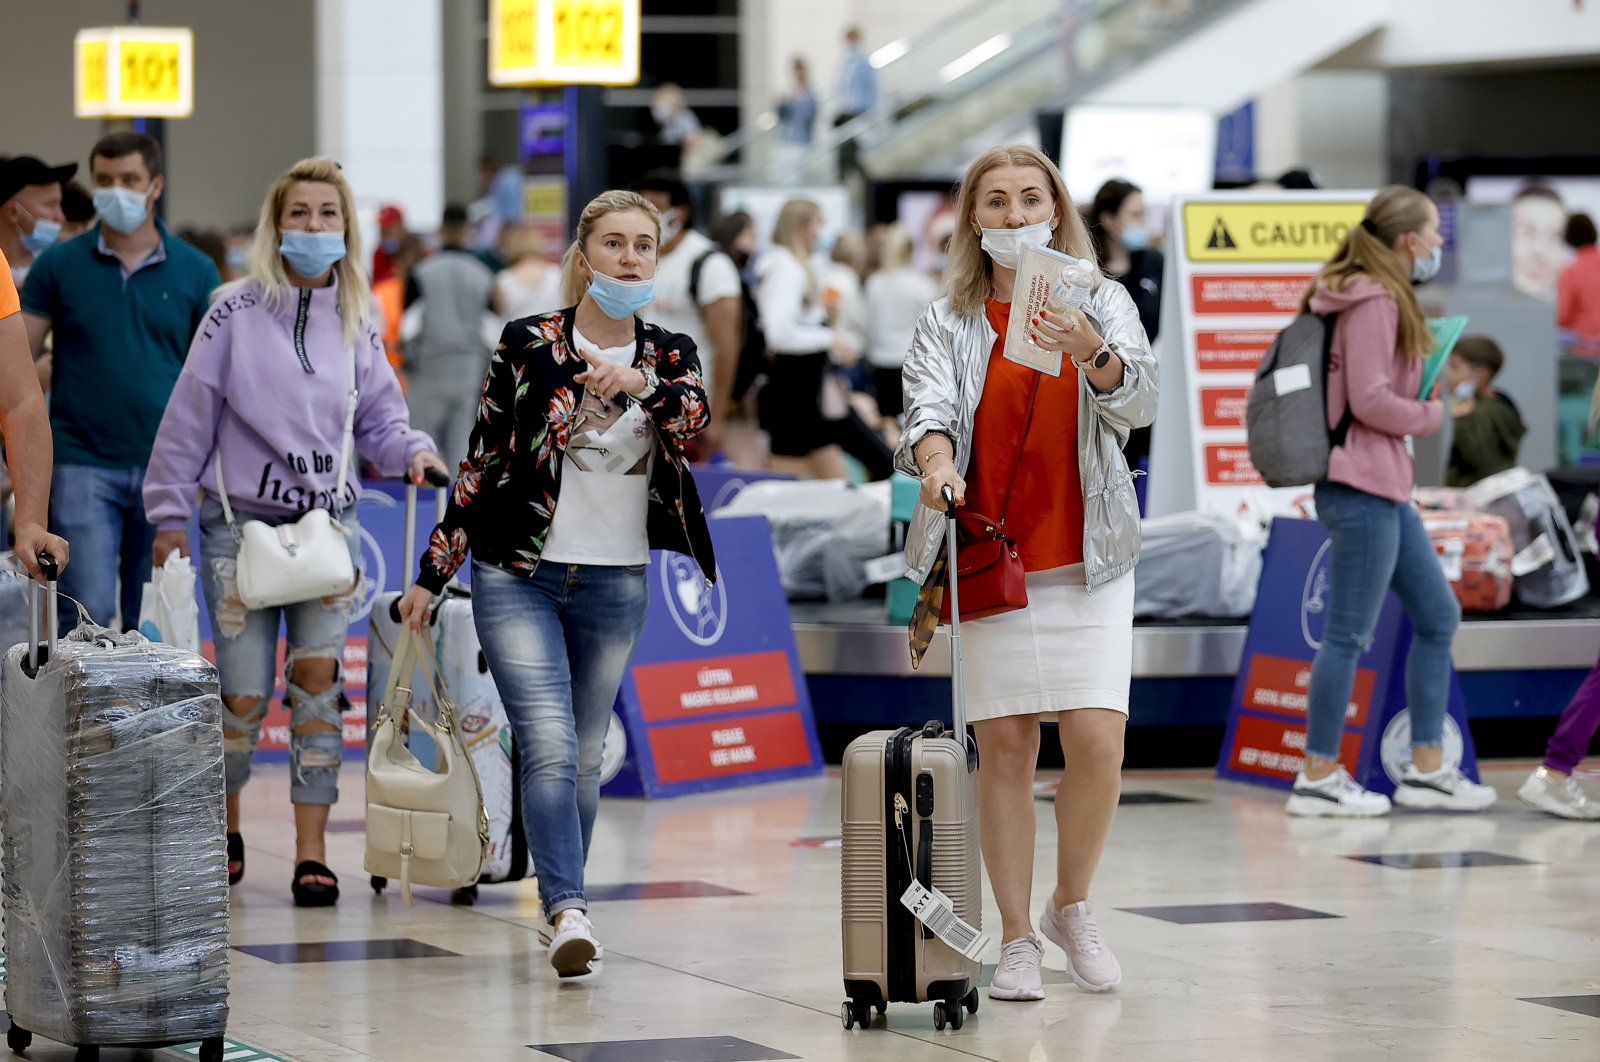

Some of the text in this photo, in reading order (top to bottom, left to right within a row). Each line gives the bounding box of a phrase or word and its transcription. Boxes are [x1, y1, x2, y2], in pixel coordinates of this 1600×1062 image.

[557, 9, 622, 54] 102
[126, 54, 178, 91] 101
[1250, 222, 1350, 247] CAUTIO
[200, 292, 256, 342] TRES
[288, 450, 333, 474] to be
[912, 893, 930, 914] AYT
